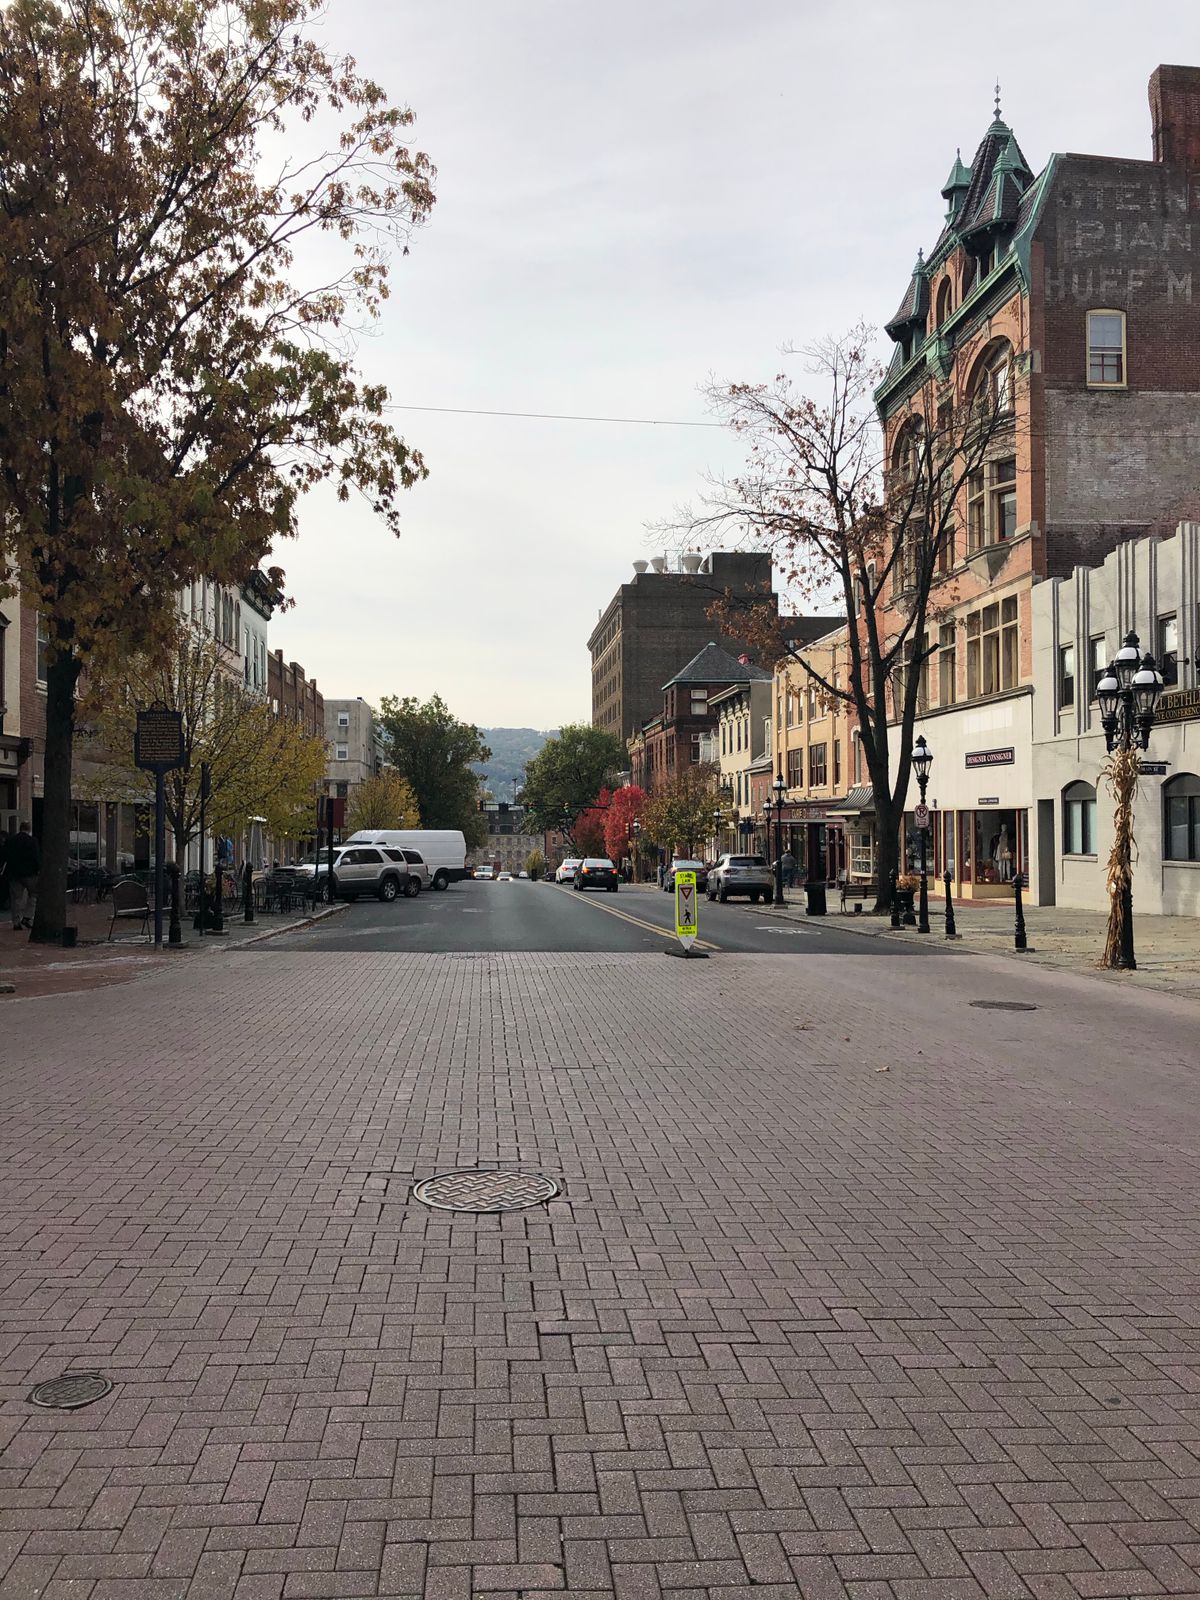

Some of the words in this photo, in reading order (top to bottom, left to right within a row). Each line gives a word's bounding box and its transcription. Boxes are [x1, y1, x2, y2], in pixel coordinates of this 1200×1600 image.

[1167, 690, 1200, 709] BETHL
[967, 755, 986, 764] DESIGNER
[987, 752, 1012, 762] CONSIGNER
